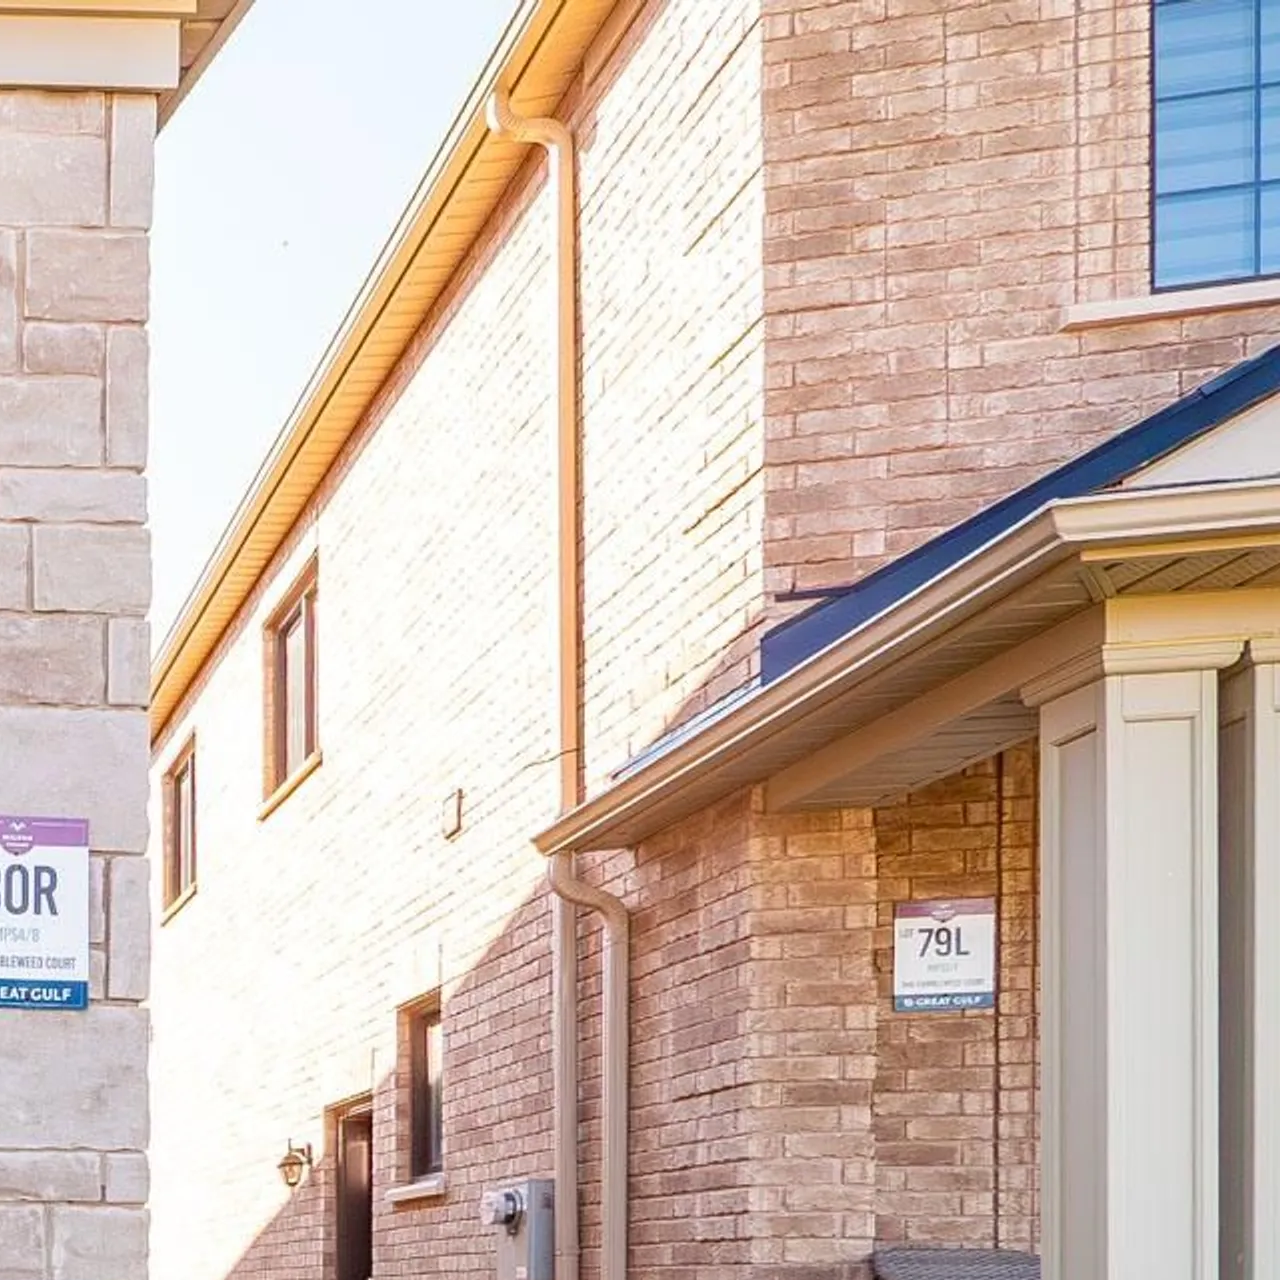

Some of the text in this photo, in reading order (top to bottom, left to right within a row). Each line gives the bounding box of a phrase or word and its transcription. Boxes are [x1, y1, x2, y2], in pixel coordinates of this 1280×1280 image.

[918, 926, 970, 957] 79L
[45, 957, 76, 969] COURT
[30, 987, 72, 1001] GULF
[916, 996, 982, 1006] GREAT GULF
